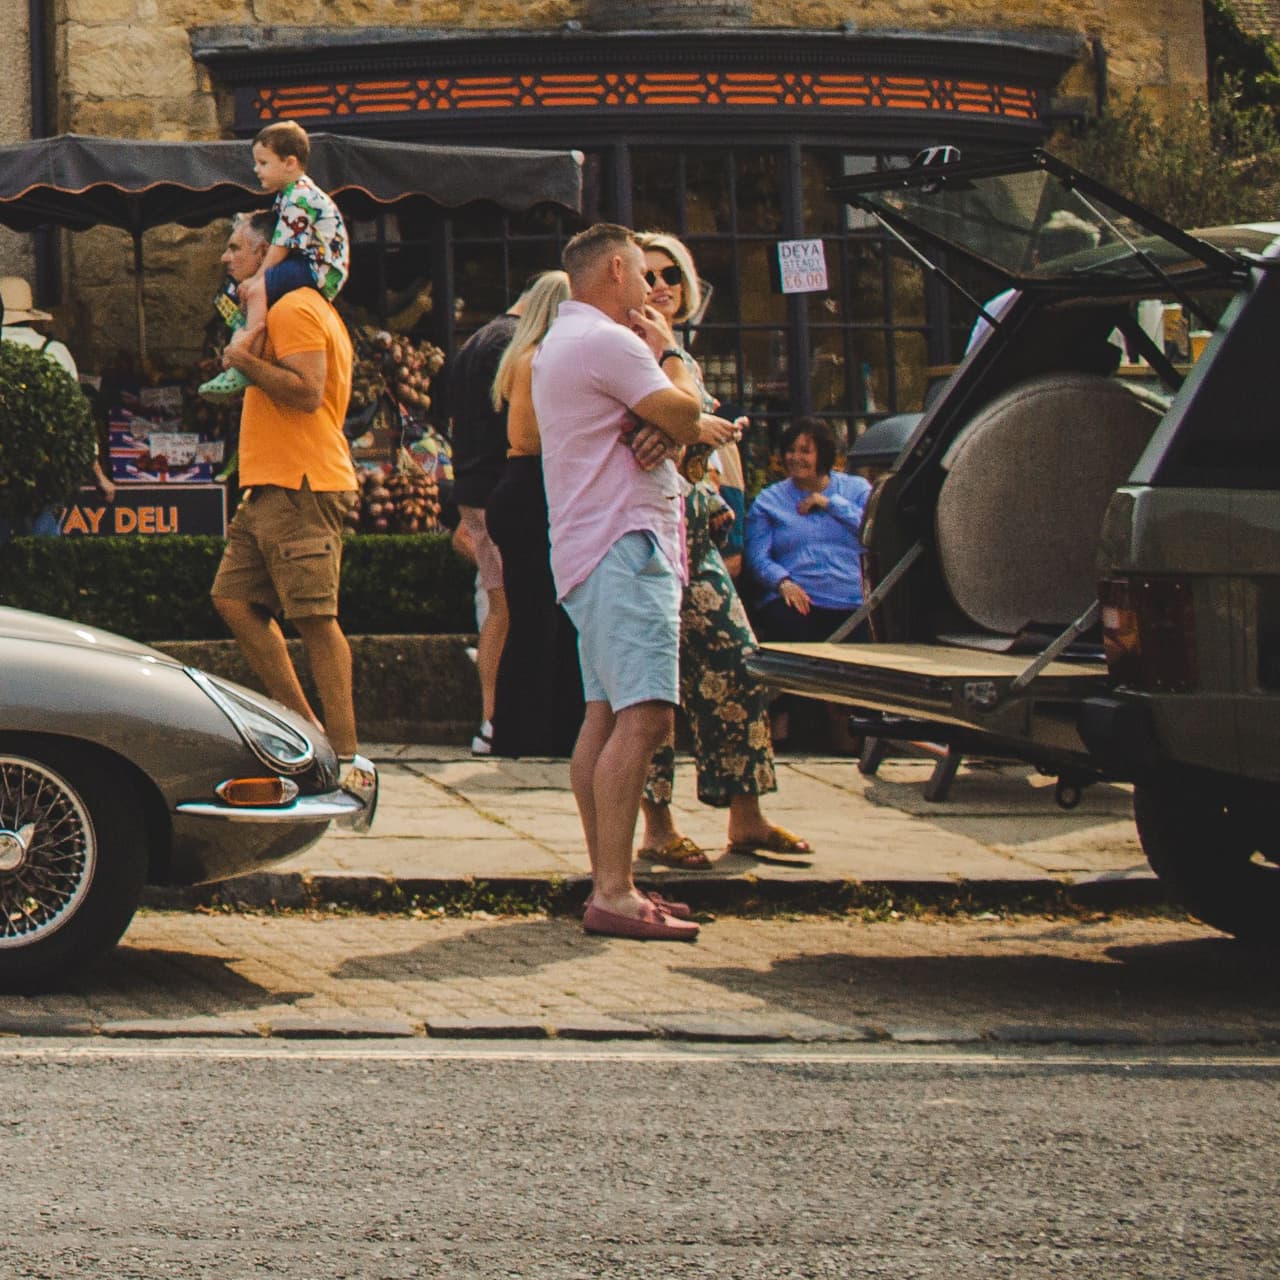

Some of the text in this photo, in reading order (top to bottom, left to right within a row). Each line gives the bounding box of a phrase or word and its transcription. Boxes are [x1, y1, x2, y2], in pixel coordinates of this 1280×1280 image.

[782, 244, 820, 258] DEYA
[59, 505, 179, 534] AY DELI
